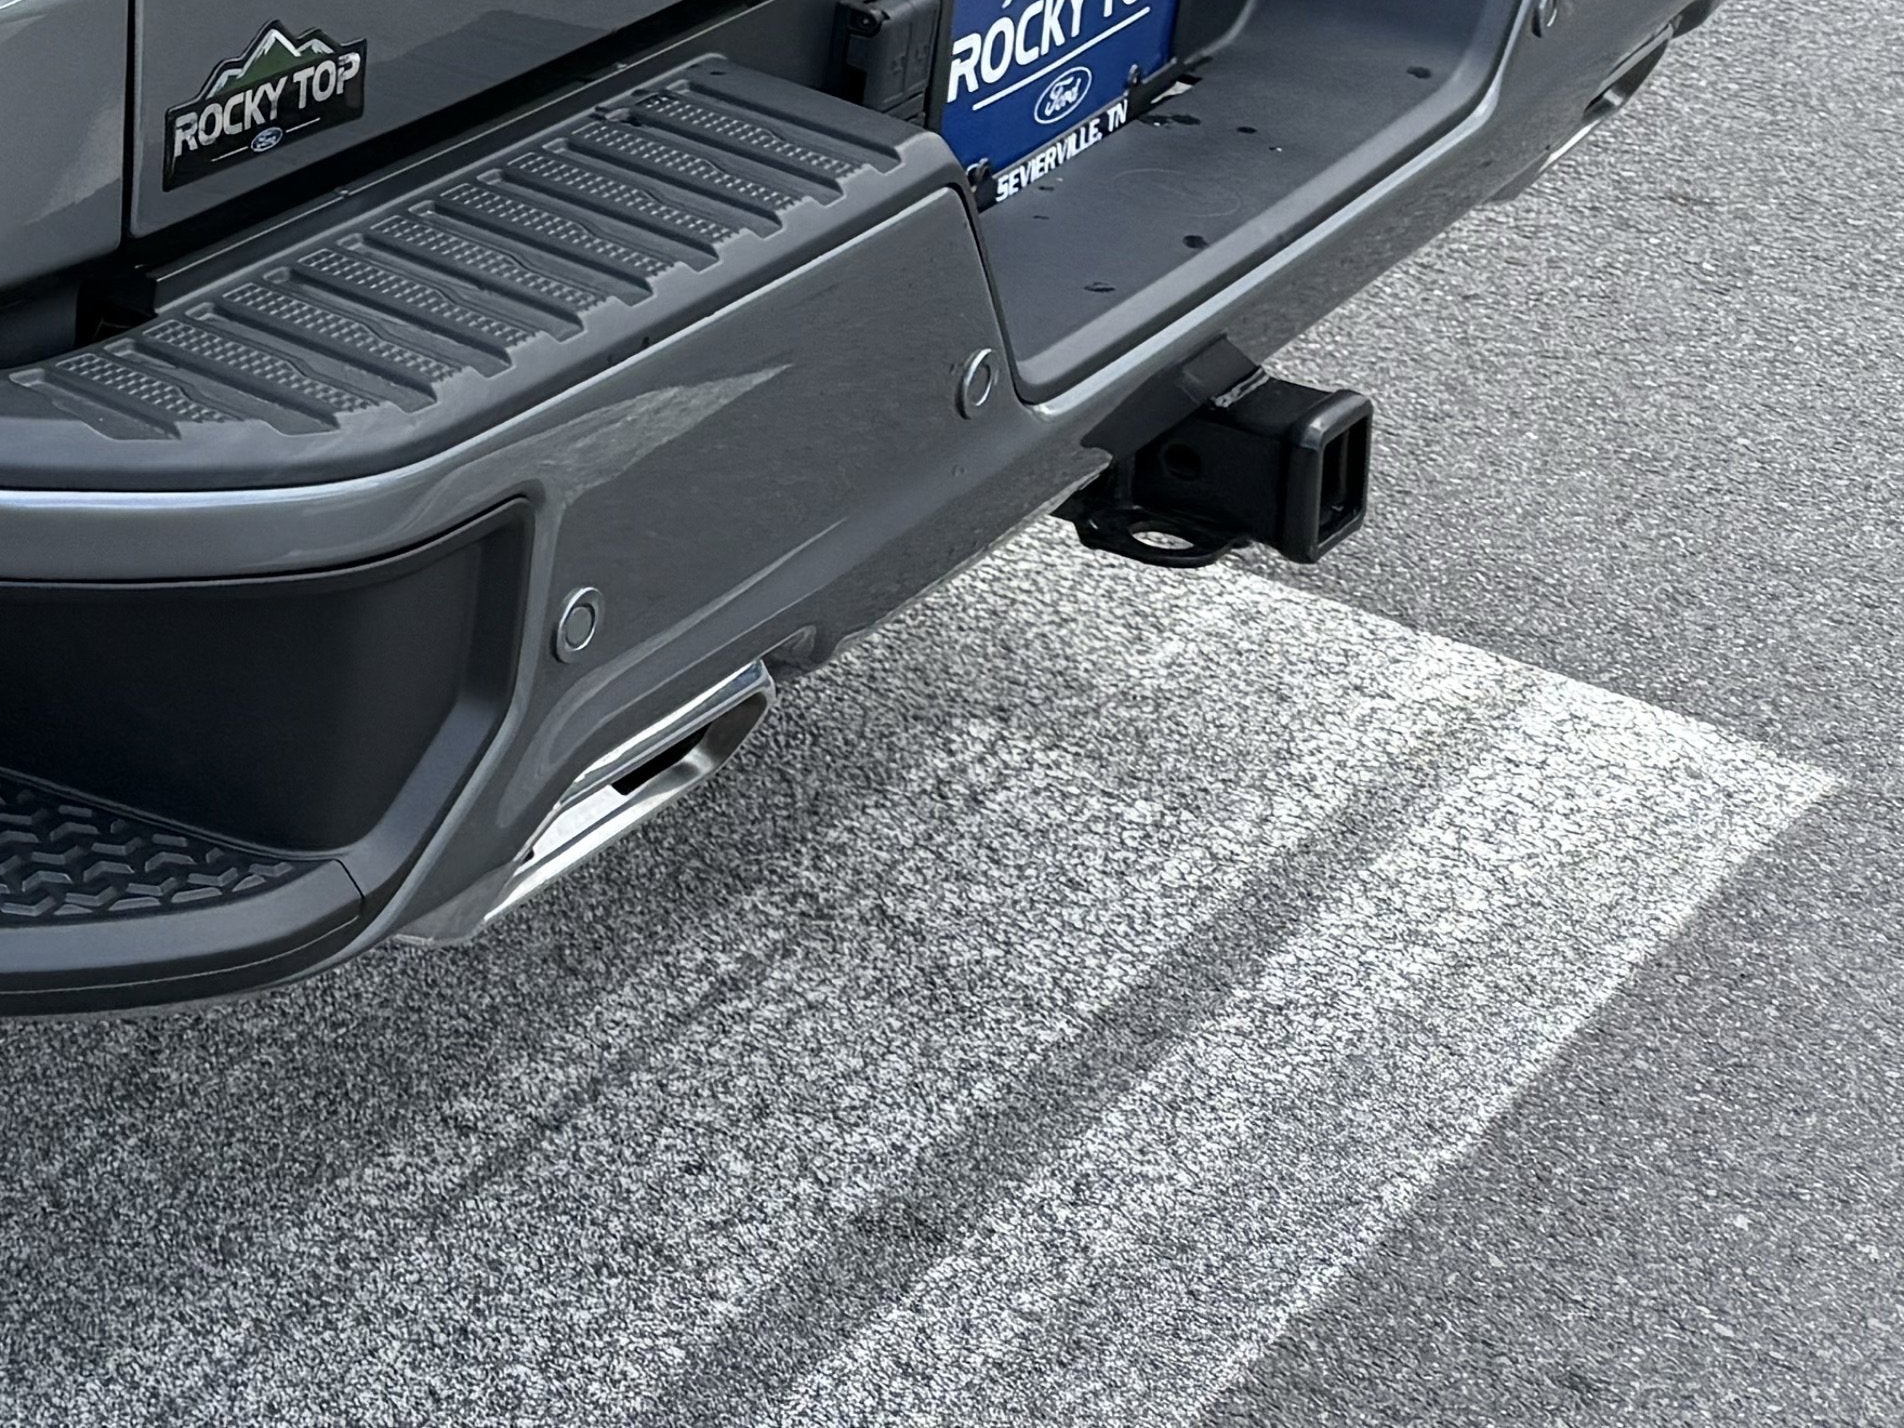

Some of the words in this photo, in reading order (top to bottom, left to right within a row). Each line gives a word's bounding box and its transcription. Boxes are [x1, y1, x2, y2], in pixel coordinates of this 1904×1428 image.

[173, 75, 289, 158] ROCKY
[293, 51, 361, 109] TOP
[1039, 72, 1087, 116] Ford
[1106, 98, 1129, 133] TN
